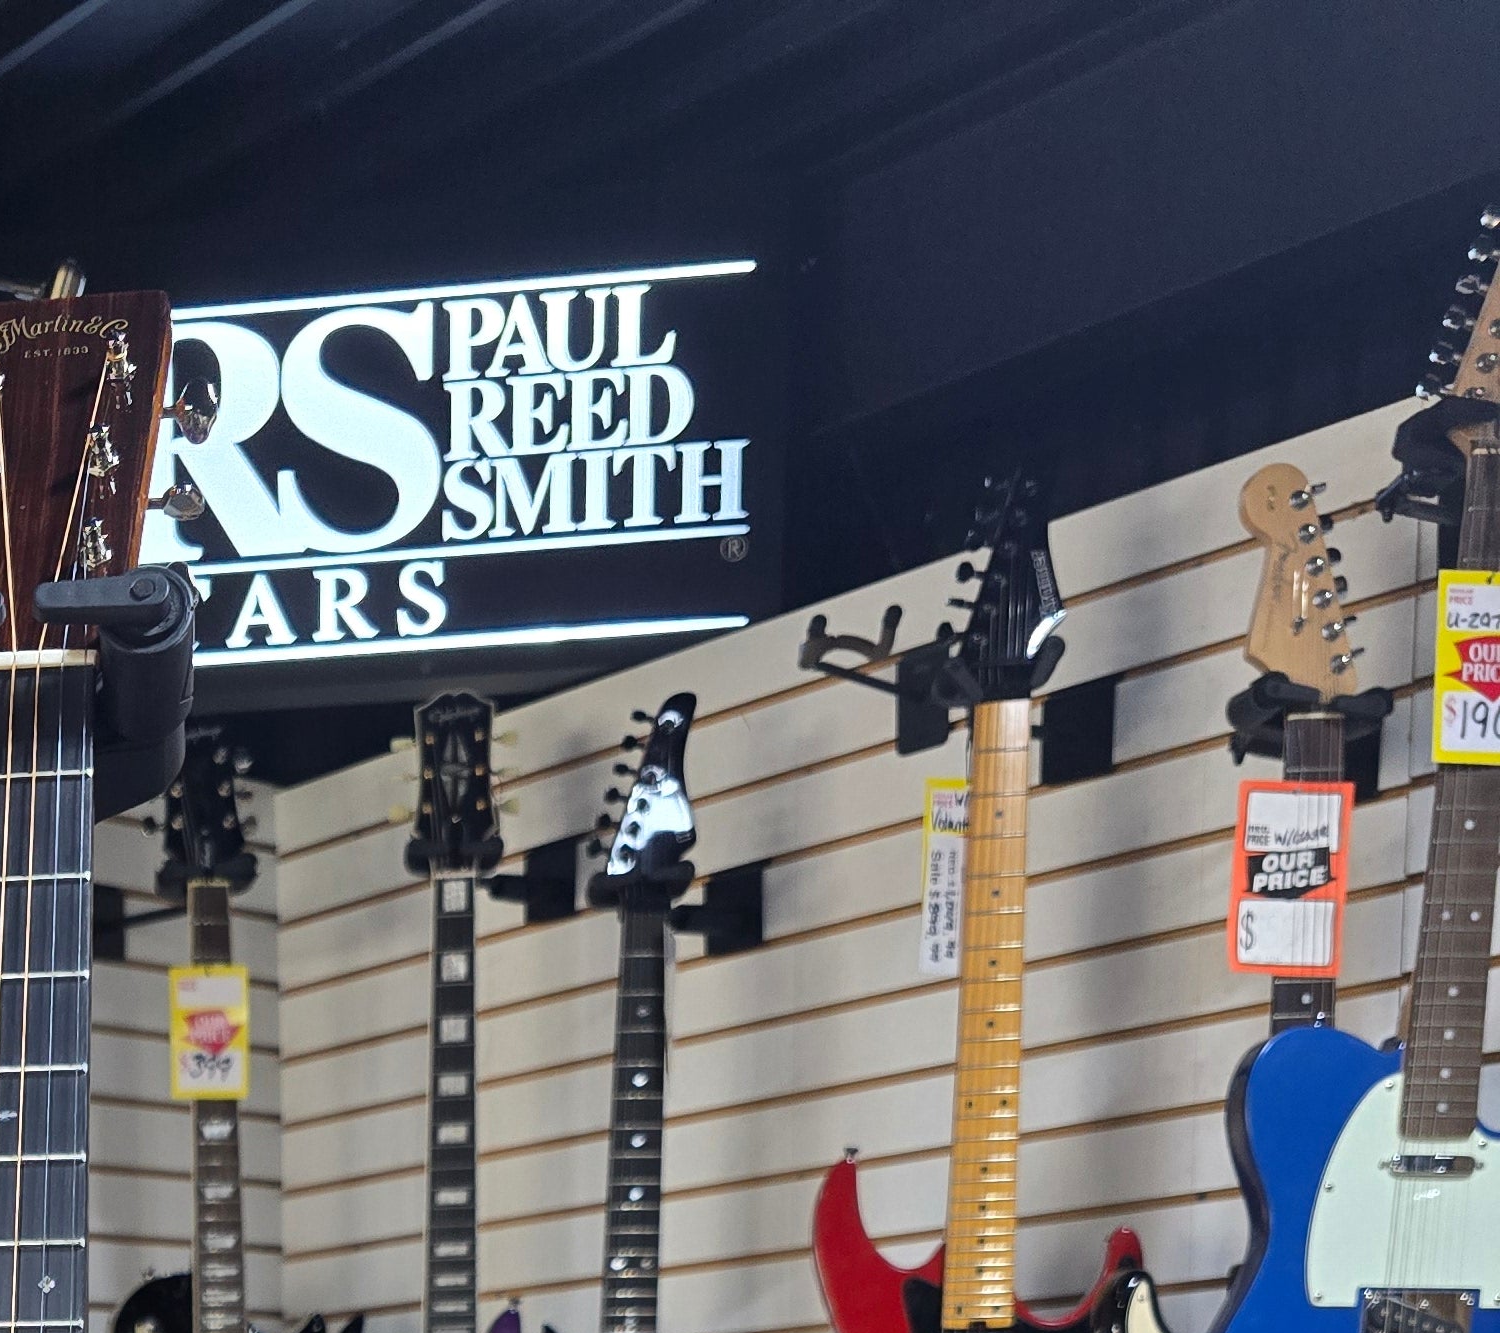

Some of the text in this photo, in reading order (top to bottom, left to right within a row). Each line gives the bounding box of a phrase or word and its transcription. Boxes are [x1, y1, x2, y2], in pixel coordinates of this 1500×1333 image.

[443, 282, 678, 381] PAUL
[140, 300, 443, 562] RS
[444, 364, 695, 464] REED
[442, 438, 752, 543] SMITH
[1252, 865, 1329, 893] PRICE
[1262, 852, 1316, 873] OUR
[1240, 909, 1255, 952] $
